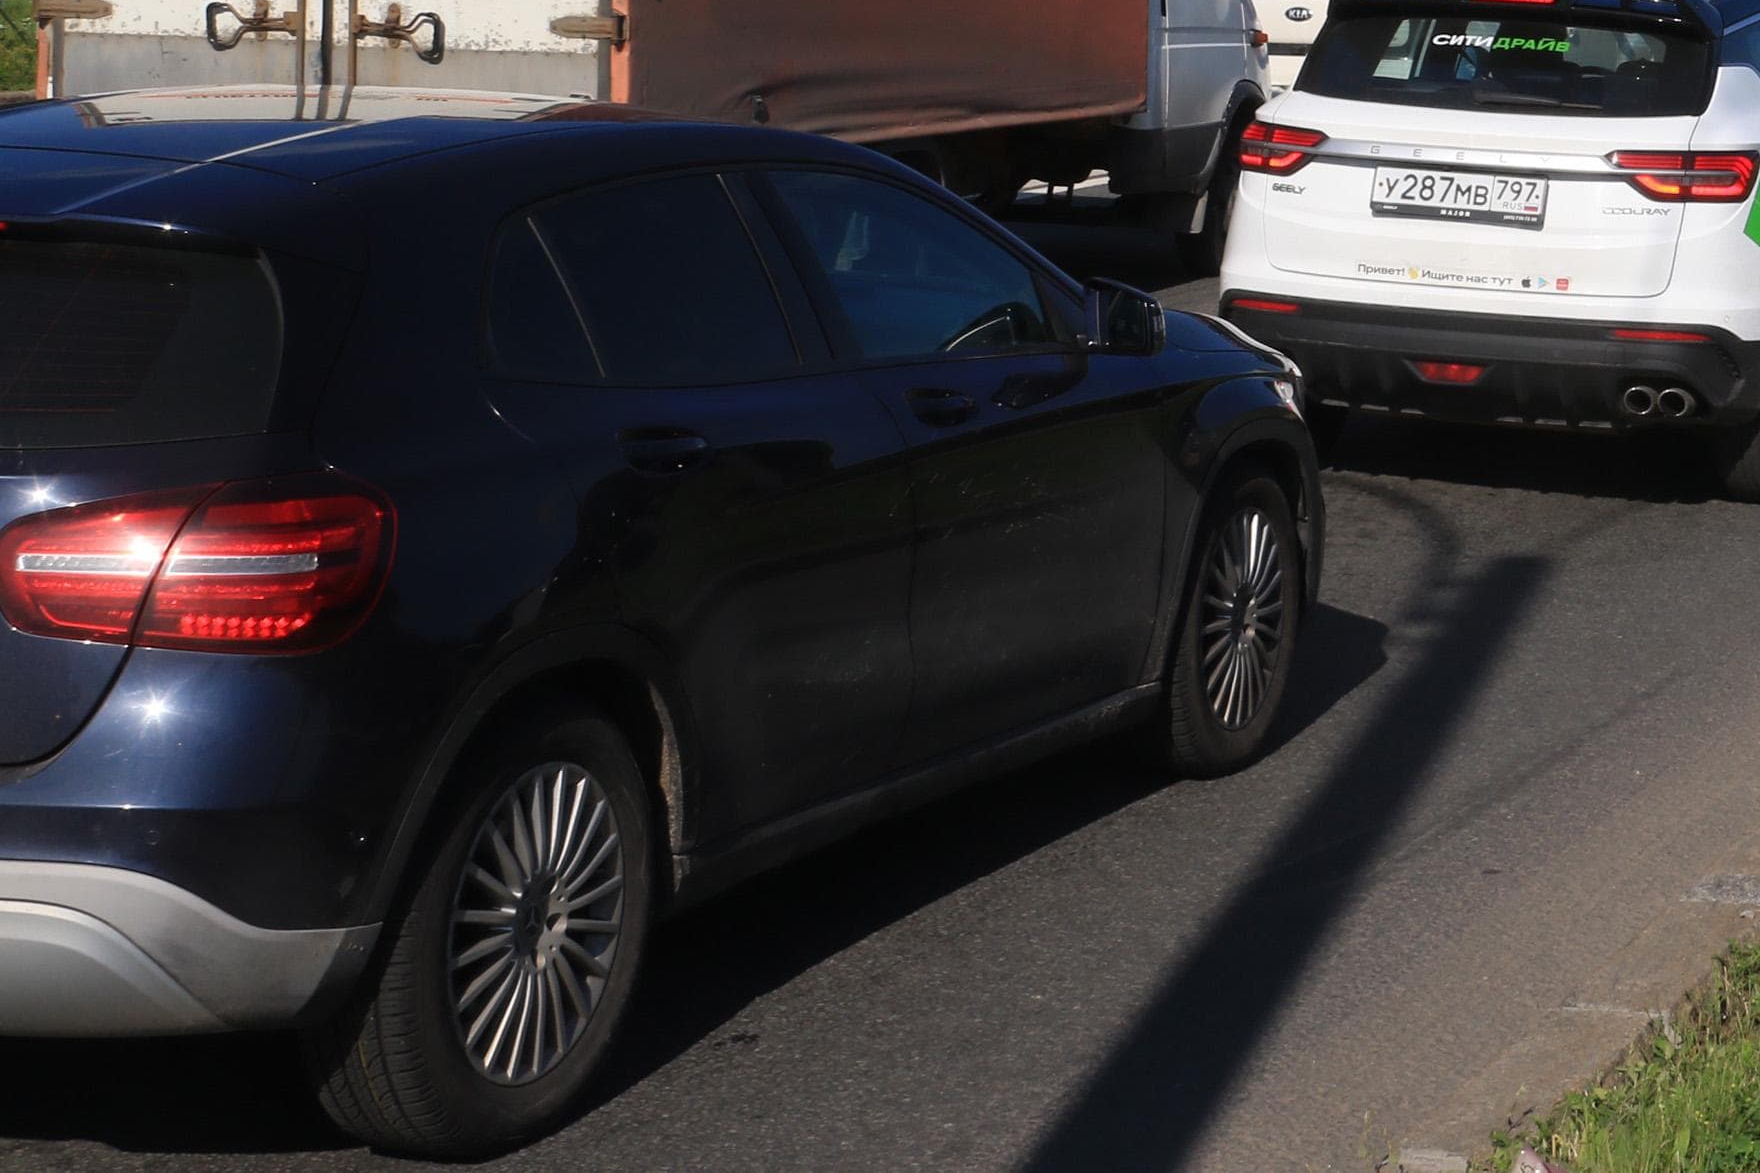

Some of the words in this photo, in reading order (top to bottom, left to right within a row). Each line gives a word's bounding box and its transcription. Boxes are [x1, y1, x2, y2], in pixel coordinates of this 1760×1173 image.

[1288, 9, 1308, 19] KIA
[1432, 34, 1571, 53] СИТИДРАЙВ
[1272, 183, 1306, 195] GEELY
[1385, 174, 1489, 206] У287МВ
[1497, 179, 1537, 202] 797
[1440, 209, 1471, 218] MAJOR
[1358, 263, 1405, 277] Привет!
[1421, 269, 1464, 282] Ищите
[1466, 275, 1488, 284] нас
[1492, 276, 1514, 287] тут
